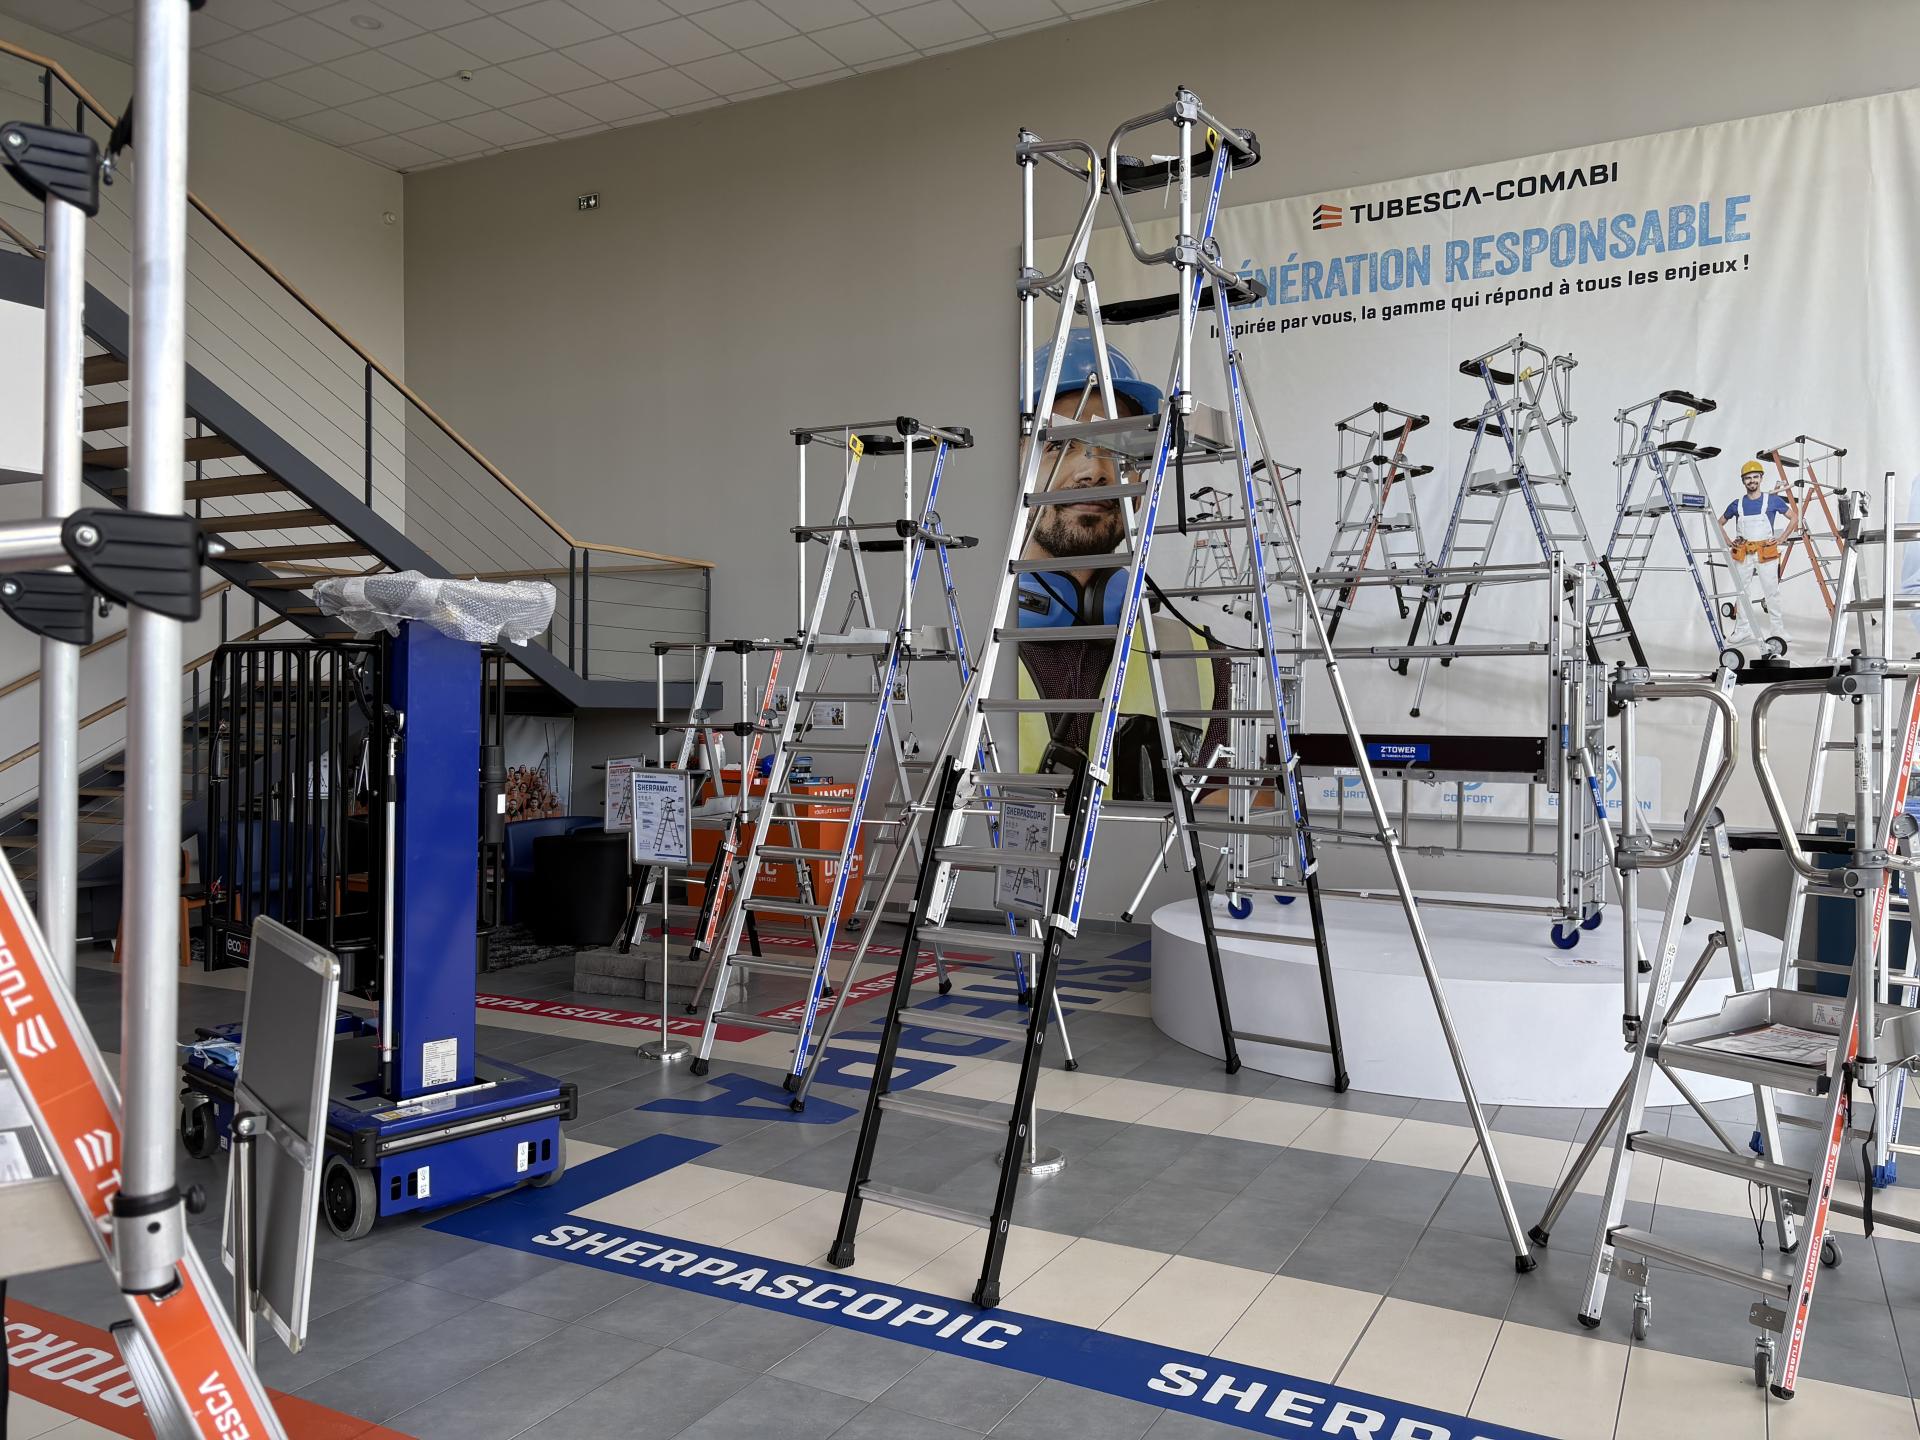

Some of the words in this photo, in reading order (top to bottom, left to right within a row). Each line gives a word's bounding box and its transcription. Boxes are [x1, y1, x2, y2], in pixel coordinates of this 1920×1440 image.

[1350, 161, 1618, 224] TUBESCA-COMABI
[1446, 194, 1751, 282] RESPONSABLE
[1281, 314, 1309, 334] par
[1312, 309, 1357, 326] vous,
[1361, 306, 1377, 320] la
[1382, 299, 1446, 321] gamme
[1451, 290, 1480, 310] qui
[1485, 281, 1553, 306] répond
[1559, 279, 1570, 295] à
[1576, 273, 1622, 293] tous
[1628, 269, 1659, 286] les
[1665, 257, 1738, 282] enjeux
[1743, 254, 1750, 271] !
[1380, 745, 1416, 754] Z'TOWER
[1904, 720, 1918, 762] TUBESCA
[637, 783, 678, 793] SHERPAMATIC
[1006, 806, 1047, 821] SHERPASCOPIC
[531, 1224, 1023, 1351] SHERPASCOPIC
[1805, 1235, 1821, 1285] TUBESCA
[1147, 1361, 1497, 1440] SHERP
